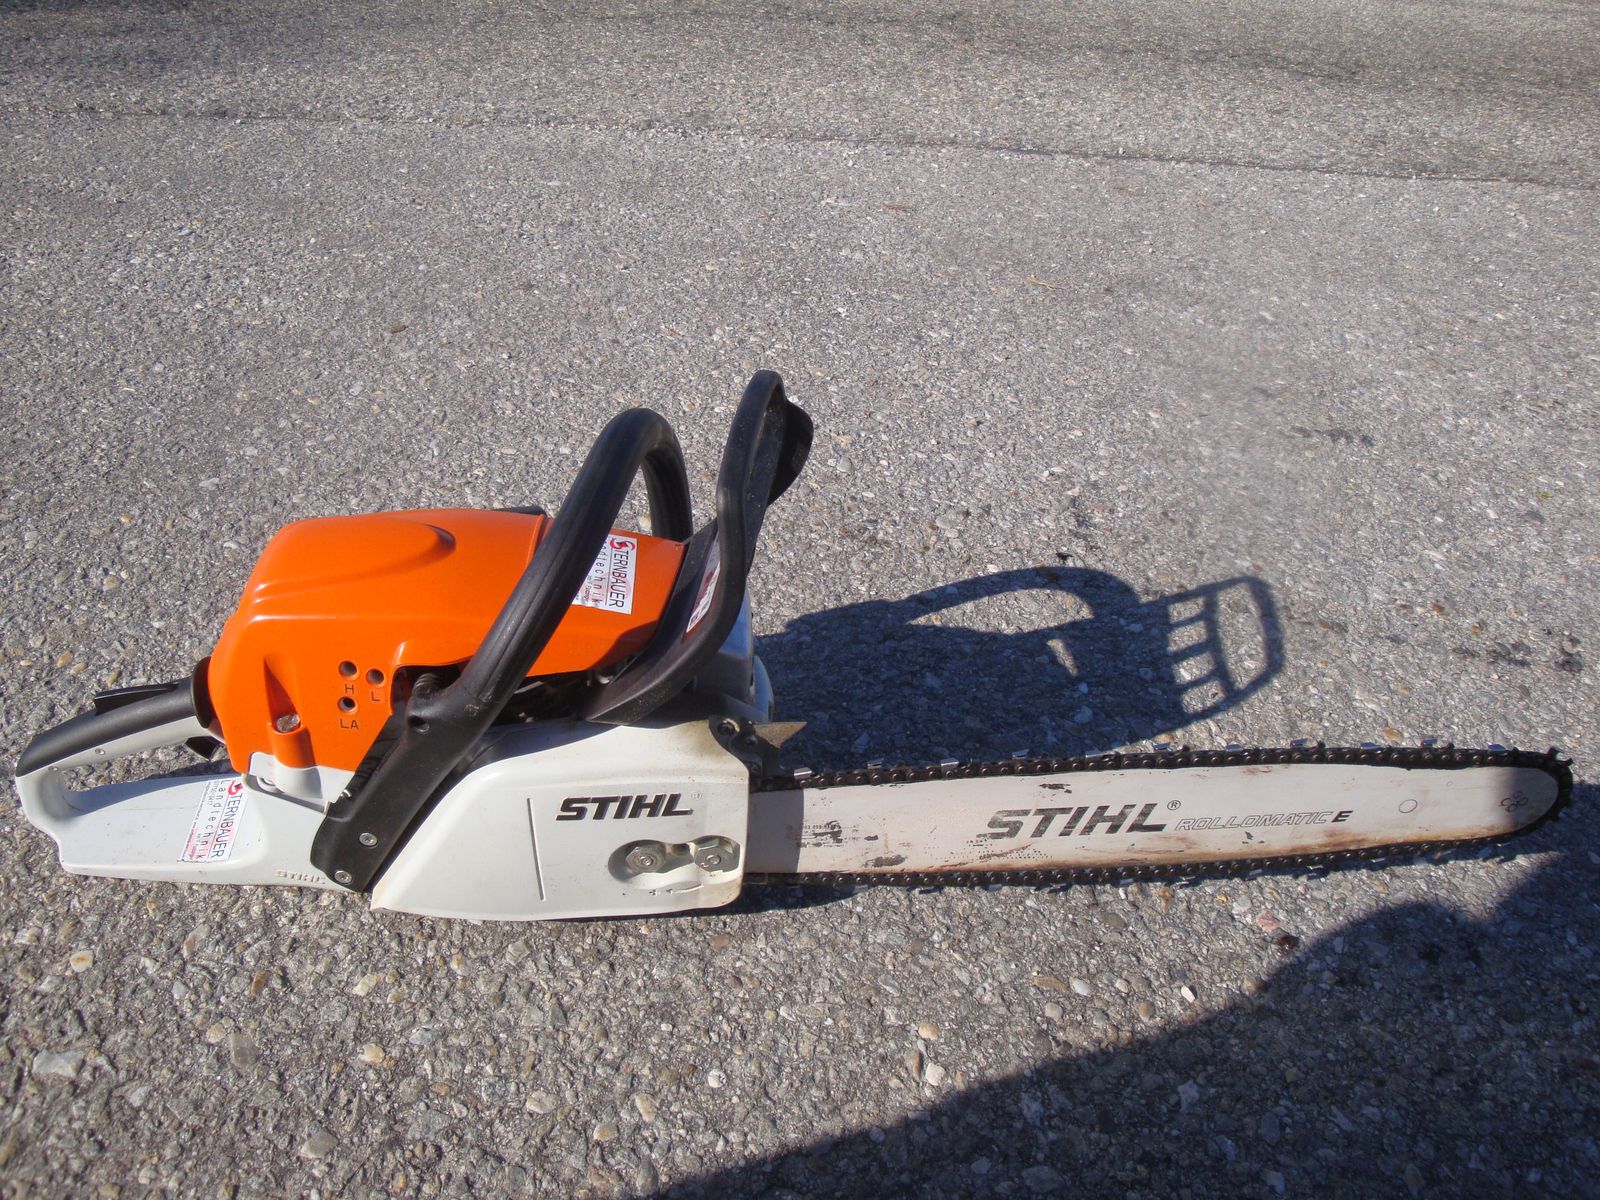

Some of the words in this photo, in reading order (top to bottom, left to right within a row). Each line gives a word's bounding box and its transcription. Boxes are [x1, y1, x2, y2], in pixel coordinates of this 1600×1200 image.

[609, 537, 636, 609] STERNBAUER
[344, 683, 355, 694] H
[370, 690, 381, 702] L
[340, 719, 359, 730] LA
[195, 780, 224, 860] Landtechnik
[211, 780, 243, 859] STERNBAUER
[556, 793, 693, 821] STIHL
[1174, 811, 1333, 832] ROLLOMATIC
[1331, 810, 1354, 823] E
[976, 803, 1167, 840] STIHL
